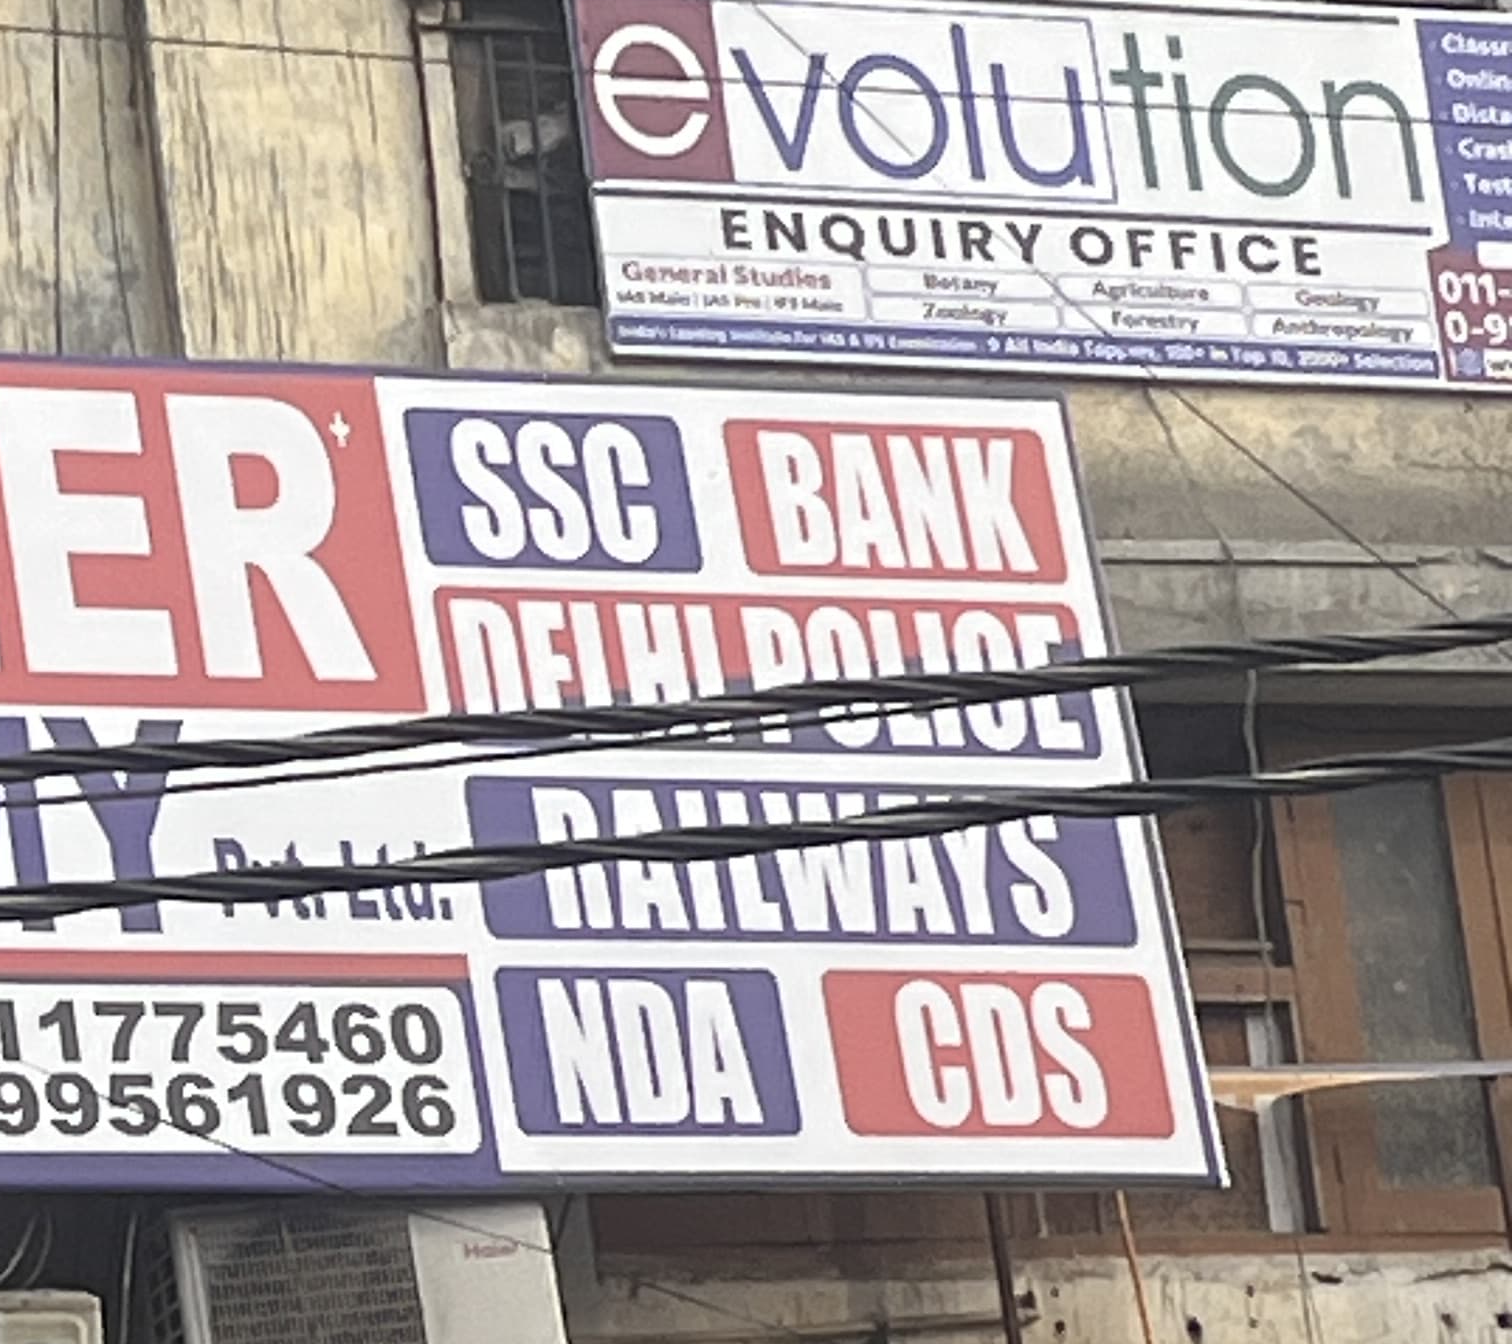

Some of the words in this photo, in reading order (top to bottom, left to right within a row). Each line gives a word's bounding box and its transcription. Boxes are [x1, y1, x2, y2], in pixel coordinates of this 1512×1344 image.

[593, 21, 1425, 202] evolution
[621, 260, 727, 284] General
[734, 265, 832, 290] Studies
[720, 208, 1042, 266] ENQUIRY
[1069, 226, 1323, 277] OFFICE
[451, 417, 663, 564] SSC
[756, 429, 1040, 573] BANK
[530, 785, 1077, 938] RAILWAYS
[536, 977, 764, 1127] NDA
[893, 979, 1110, 1130] CDS
